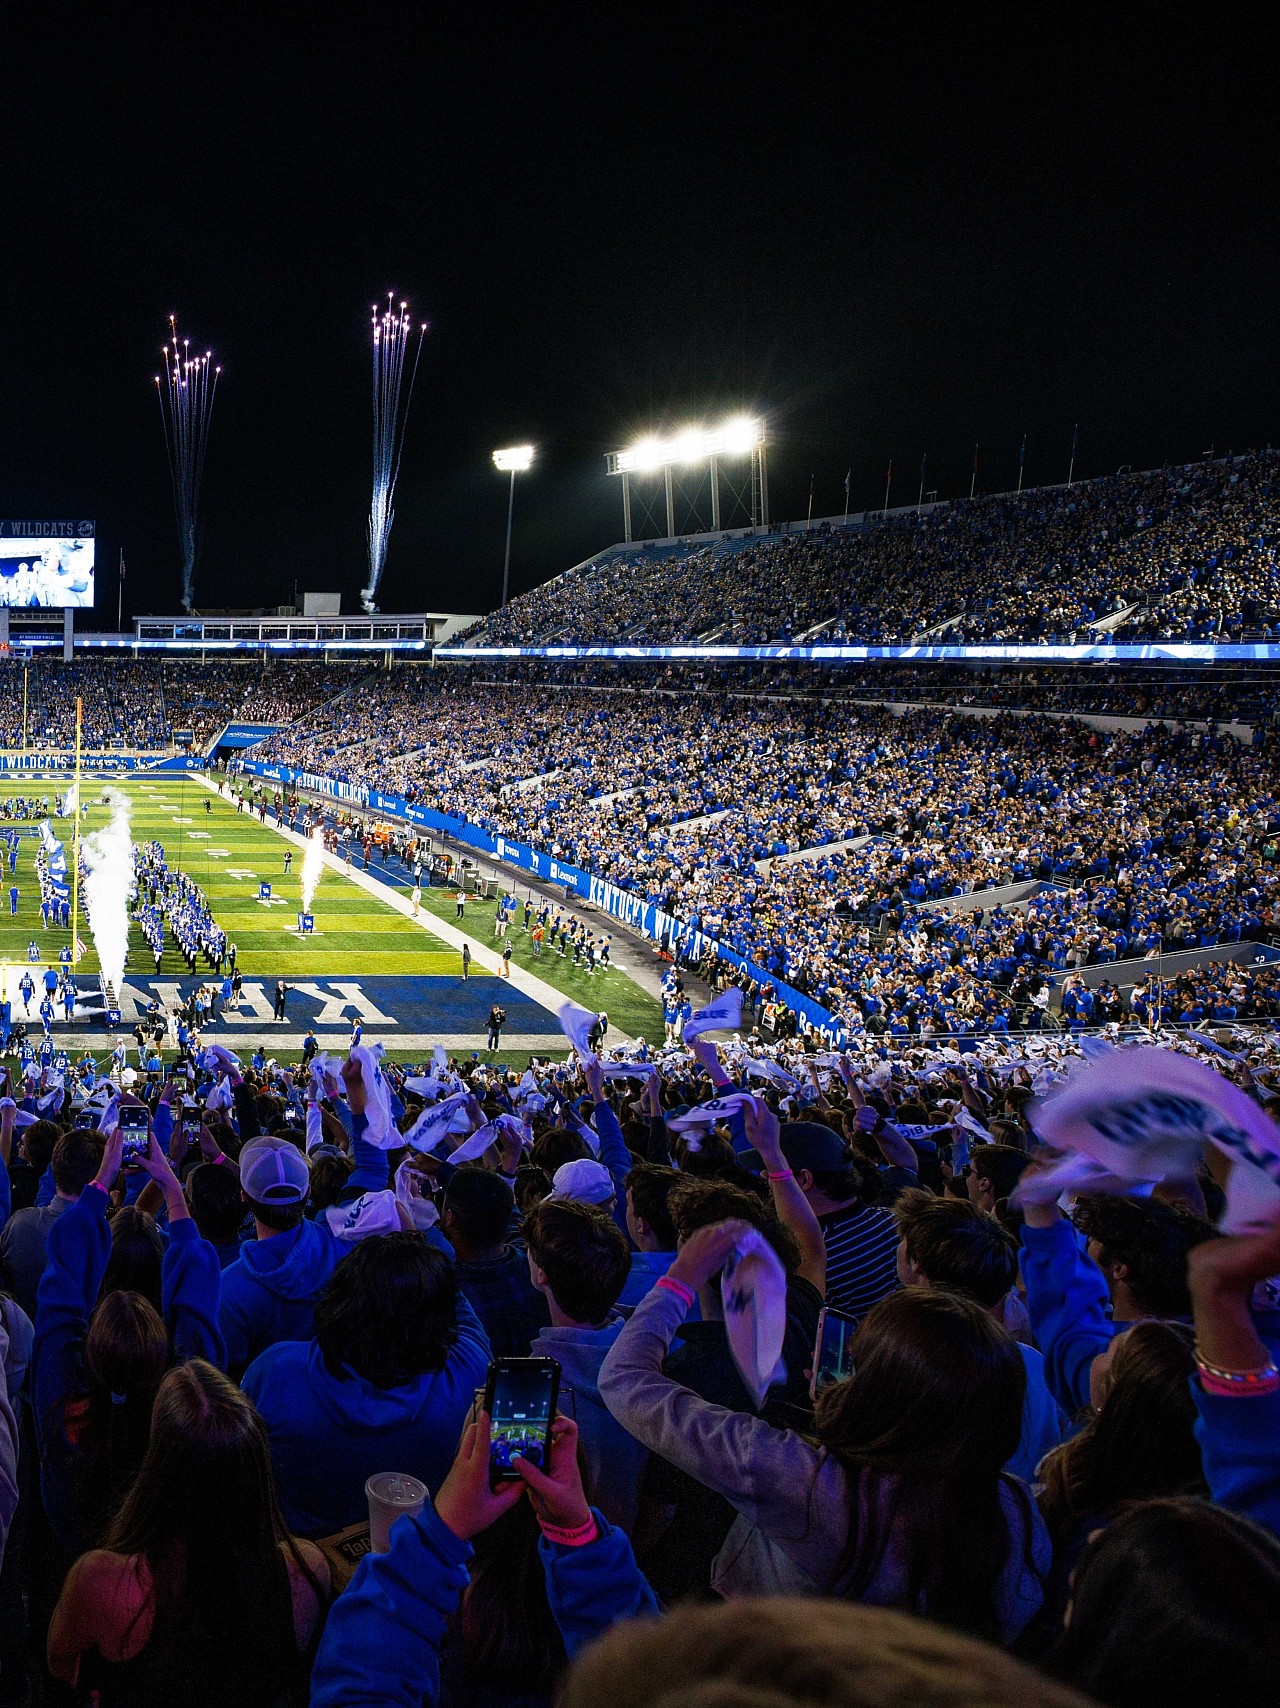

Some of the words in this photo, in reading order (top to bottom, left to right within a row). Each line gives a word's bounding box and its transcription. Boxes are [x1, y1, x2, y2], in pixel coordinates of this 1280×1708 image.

[11, 521, 74, 537] WILDCATS
[8, 756, 67, 769] WILDCATS
[302, 773, 335, 796] KENTUCKY
[338, 781, 370, 806] WILDCATS
[557, 867, 578, 886] Lexmark
[589, 876, 649, 932] KENTUCKY
[23, 1050, 33, 1059] 12
[42, 1044, 51, 1054] 16
